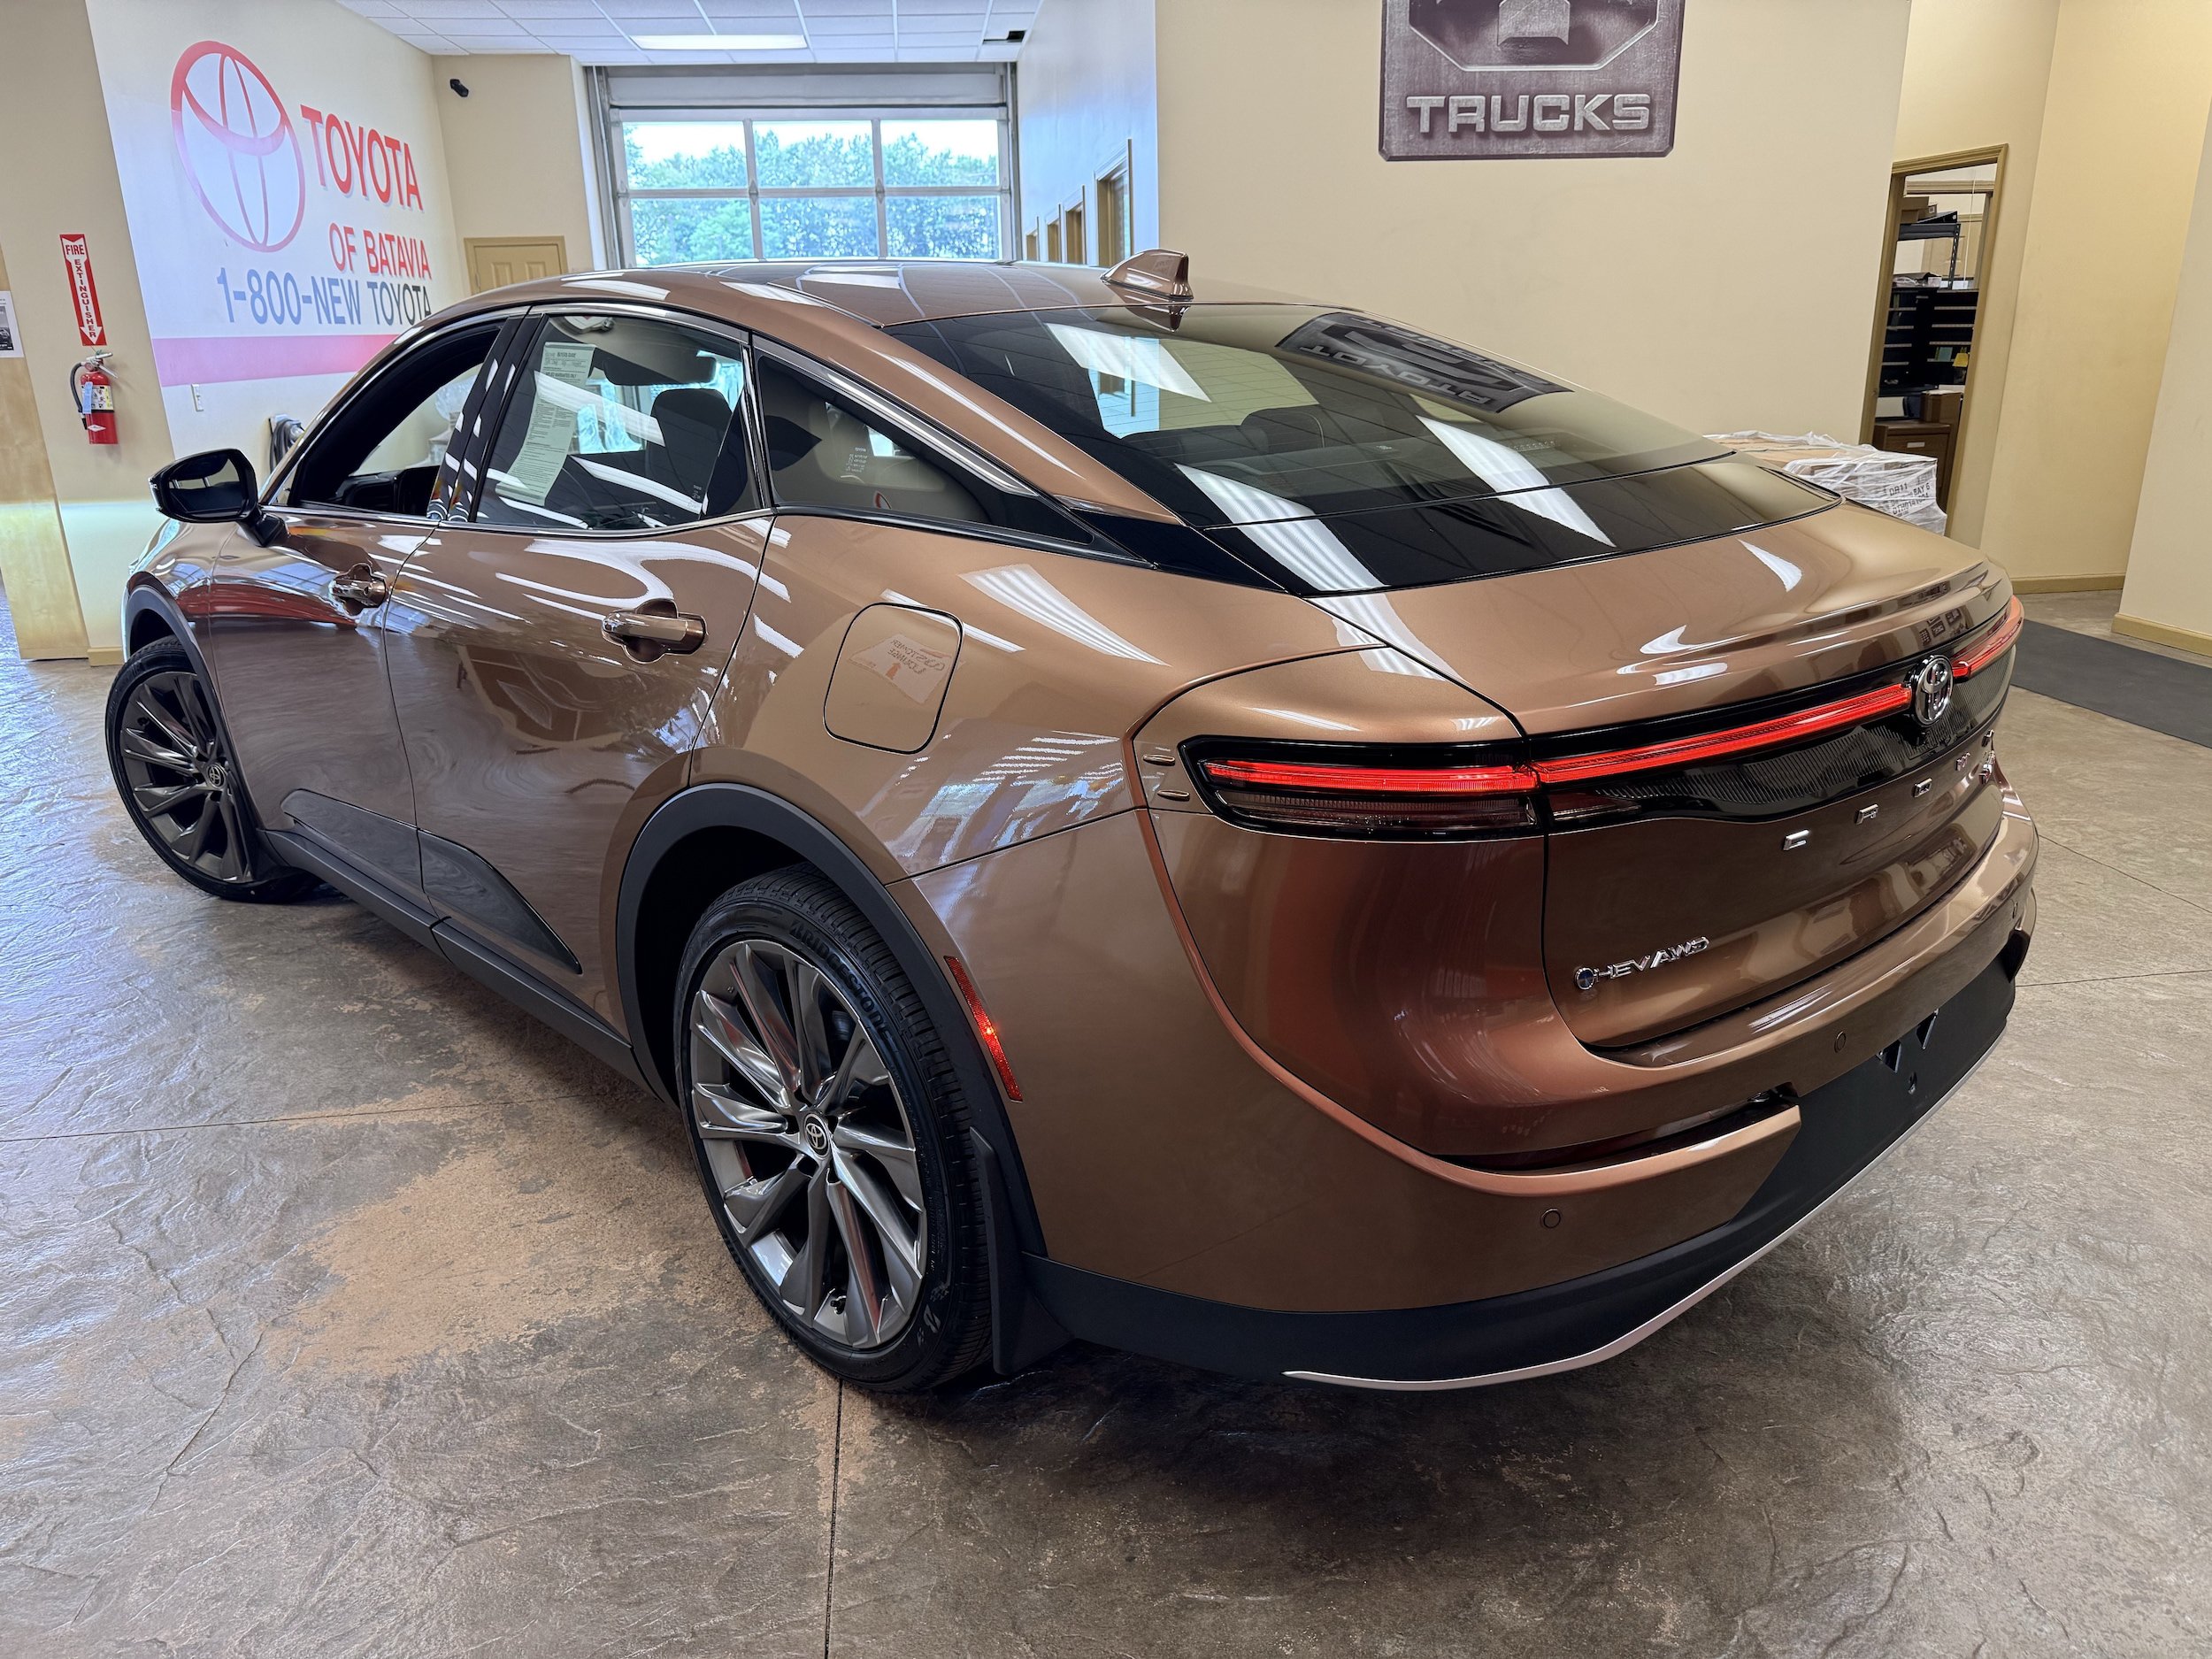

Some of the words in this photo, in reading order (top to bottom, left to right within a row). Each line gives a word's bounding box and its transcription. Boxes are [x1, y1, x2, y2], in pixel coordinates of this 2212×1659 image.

[1406, 94, 1651, 134] TRUCKS
[300, 104, 424, 211] TOYOTA
[65, 244, 85, 255] FIRE
[328, 222, 356, 273] OF
[363, 229, 432, 280] BATAVIA
[74, 259, 96, 338] EXTINGUISHER
[217, 267, 362, 325] 1-800-NEW
[366, 280, 432, 326] TOYOTA
[1650, 935, 1710, 969] AWD
